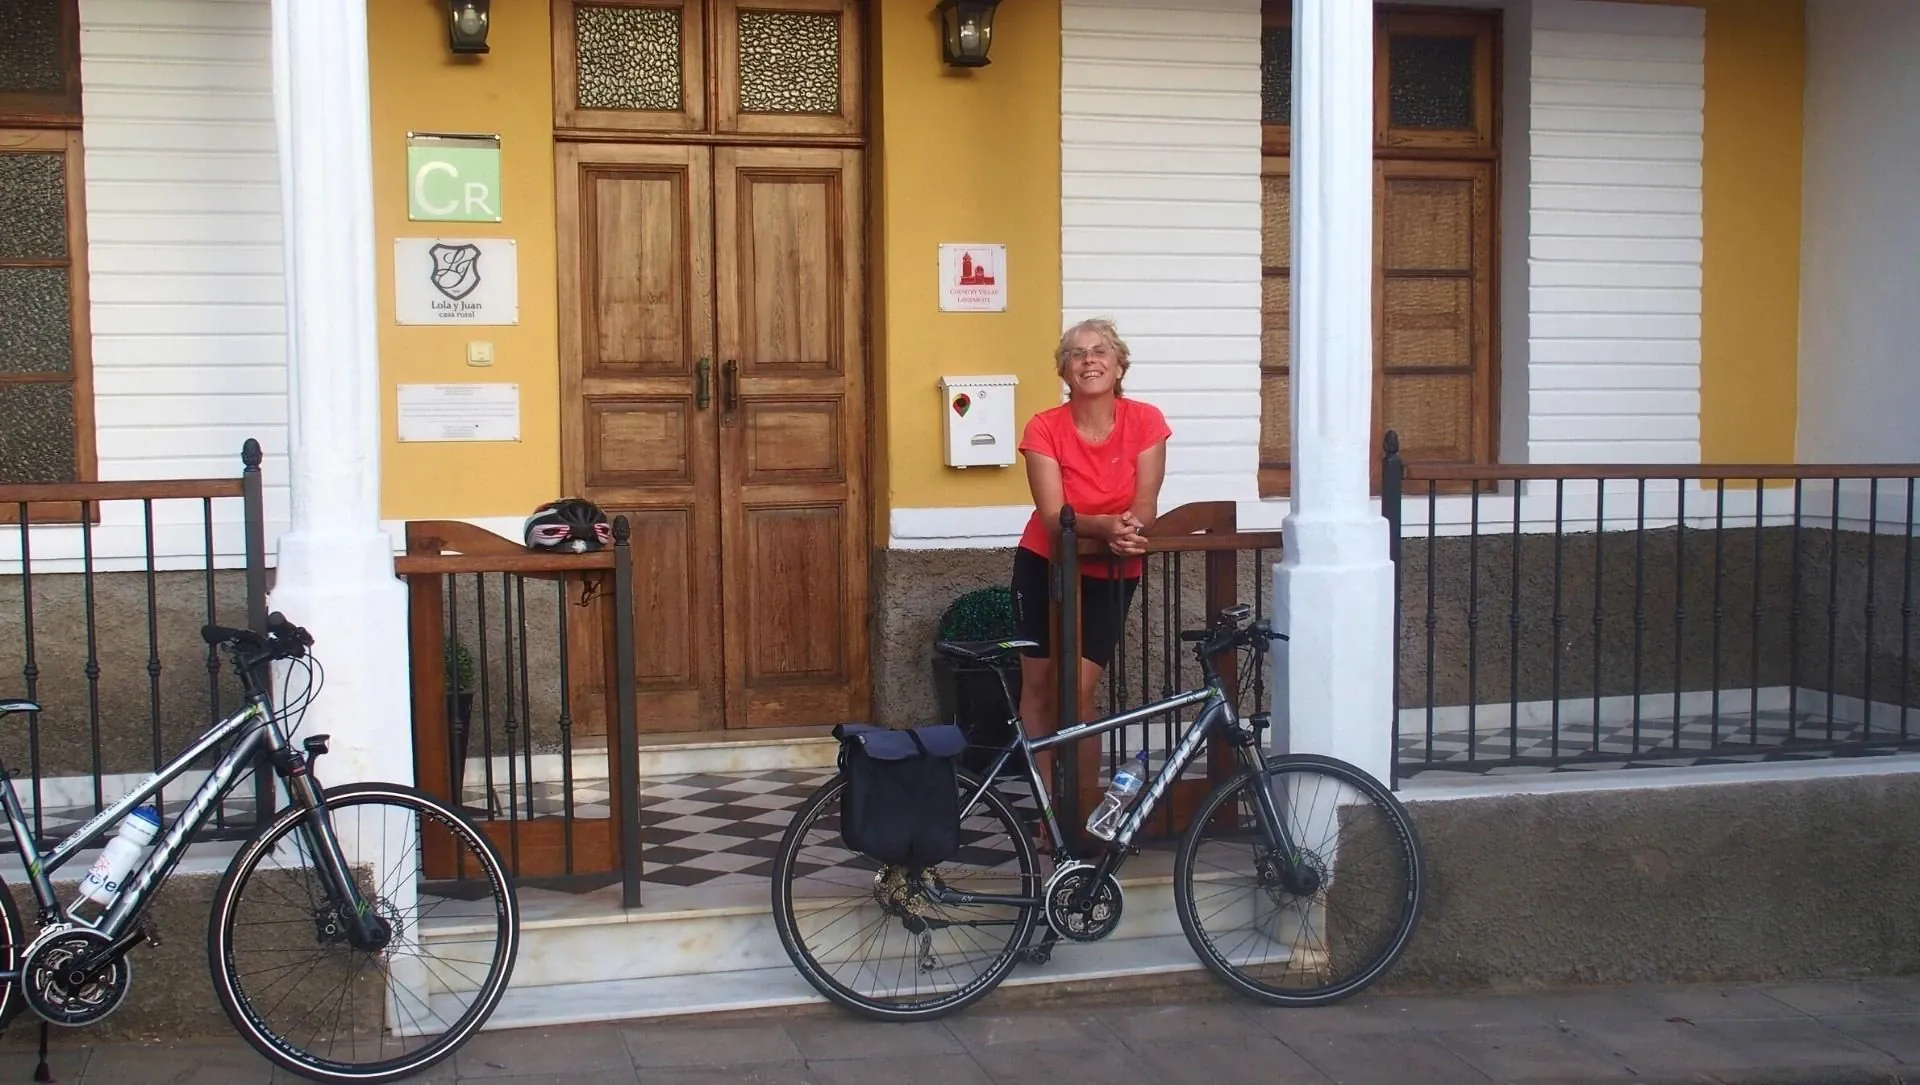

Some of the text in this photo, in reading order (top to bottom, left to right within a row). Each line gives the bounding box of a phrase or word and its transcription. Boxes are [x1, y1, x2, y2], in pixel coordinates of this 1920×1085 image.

[431, 300, 482, 312] Lola y Juan
[1116, 722, 1202, 845] STEVENS
